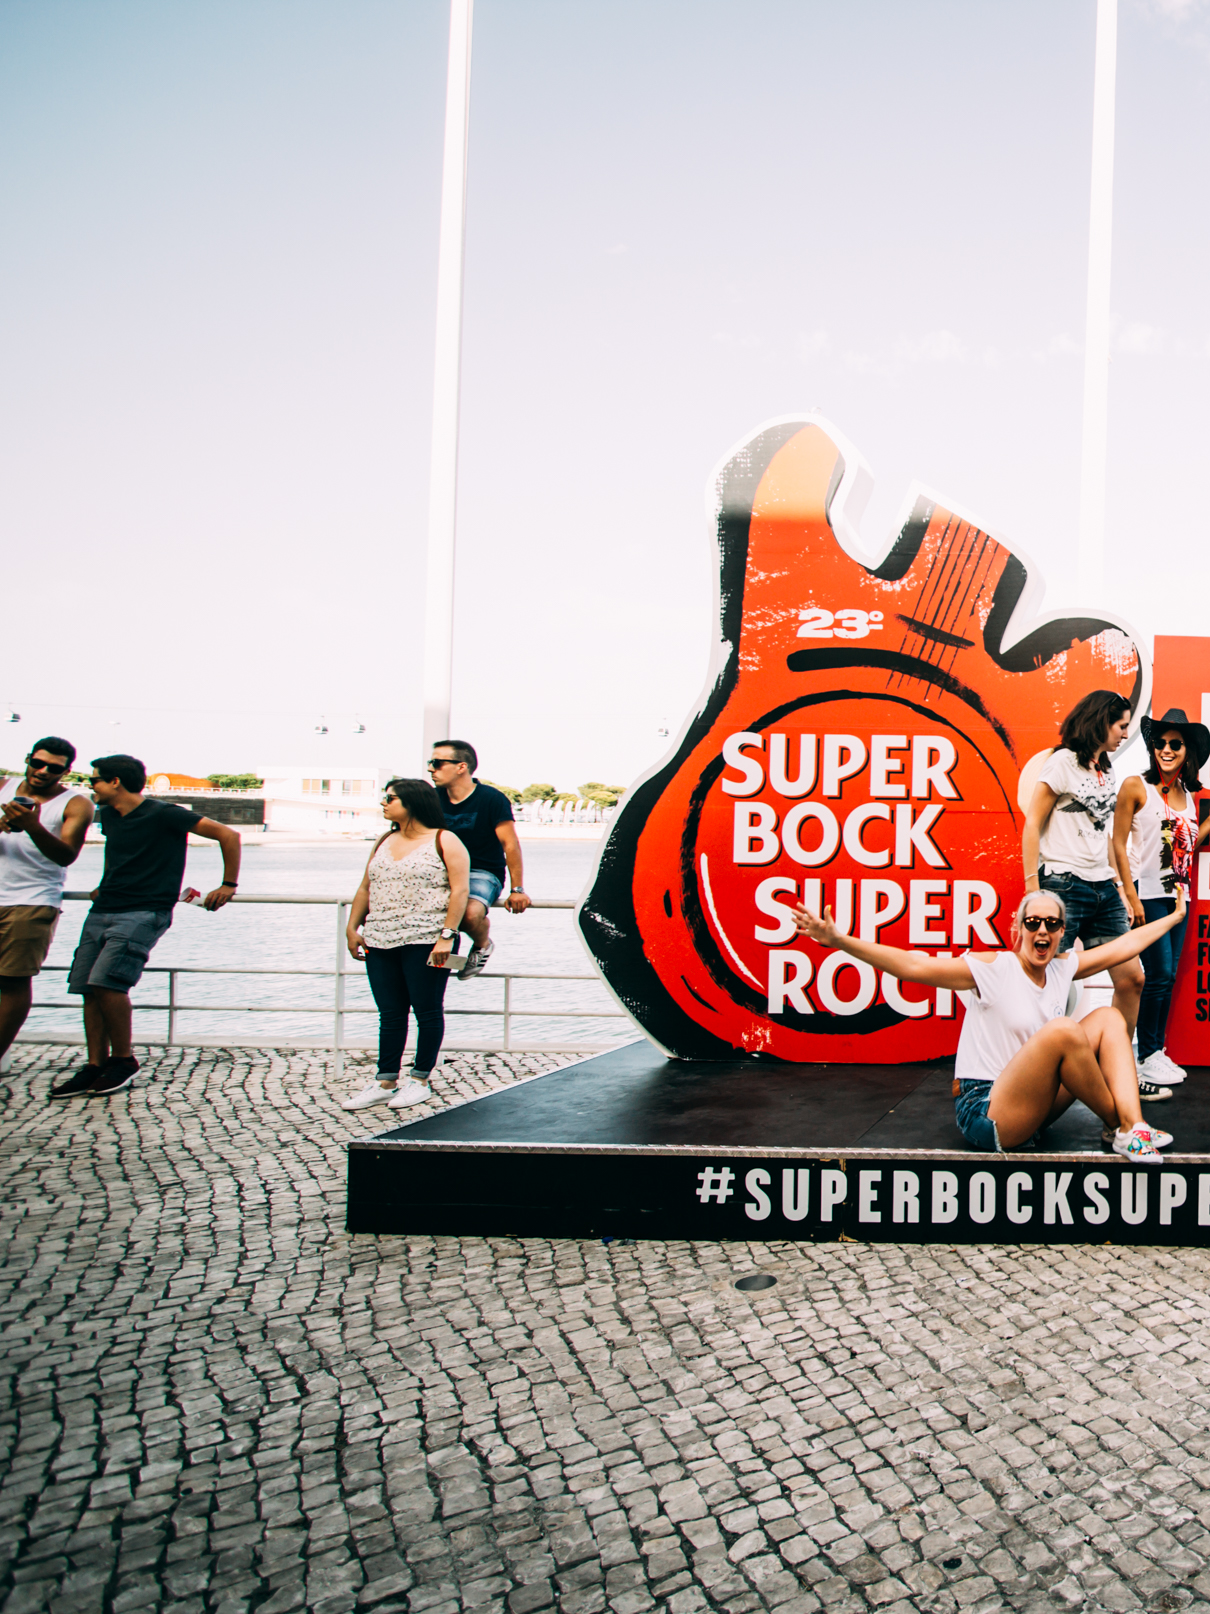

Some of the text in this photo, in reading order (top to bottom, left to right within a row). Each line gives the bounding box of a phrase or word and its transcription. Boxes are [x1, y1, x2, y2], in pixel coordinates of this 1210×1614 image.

[721, 732, 963, 800] SUPER
[733, 801, 952, 869] BOCK
[754, 876, 1006, 947] SUPER
